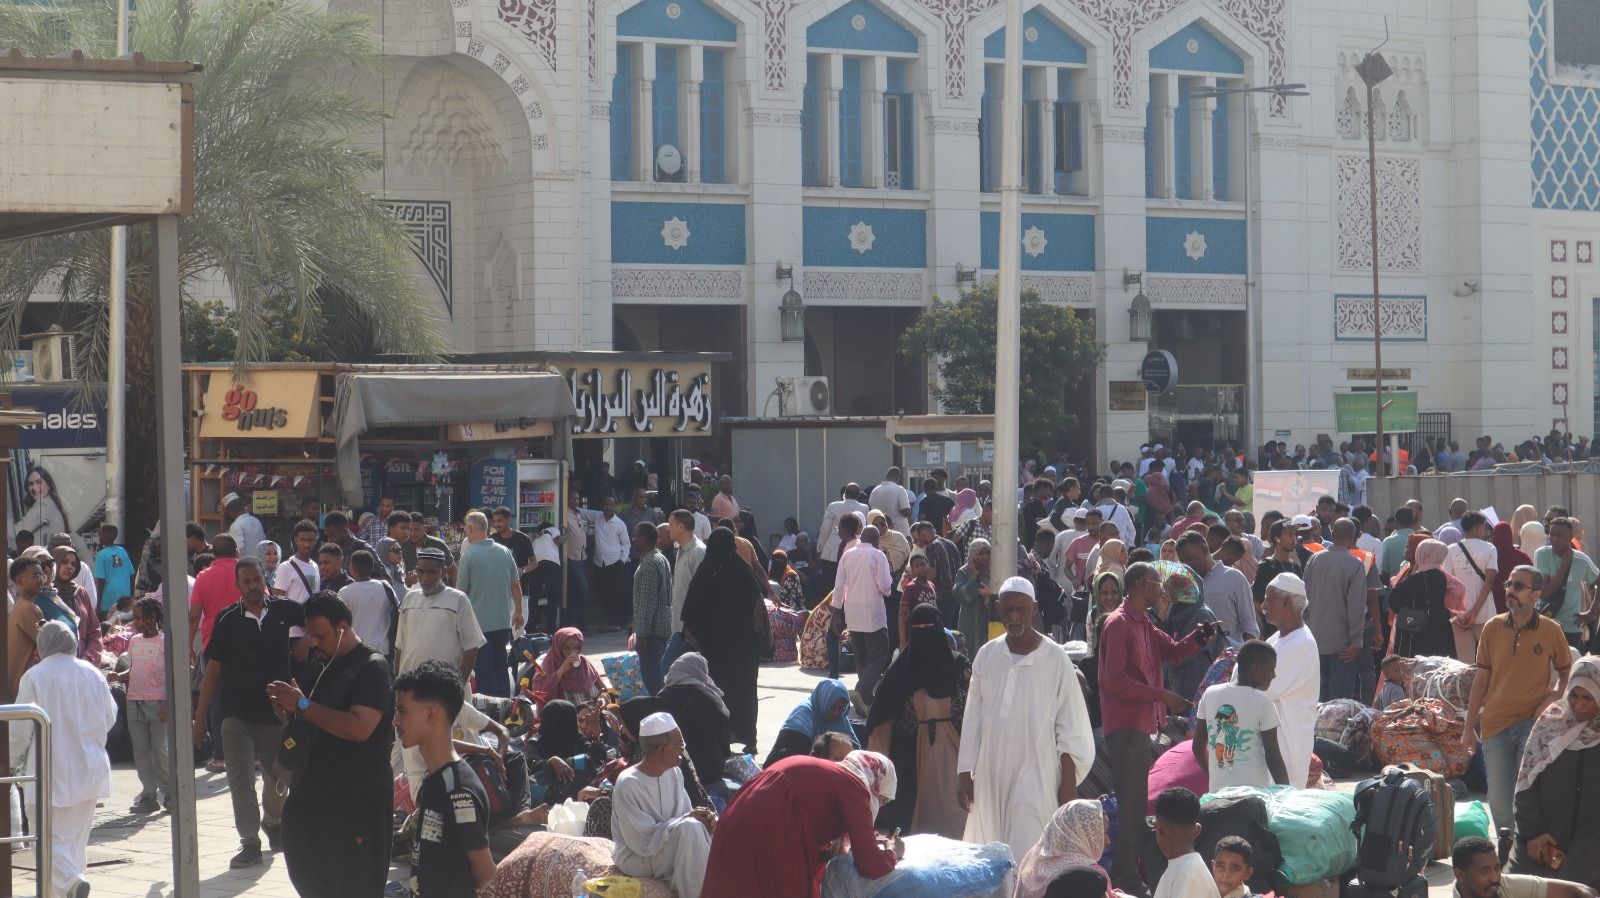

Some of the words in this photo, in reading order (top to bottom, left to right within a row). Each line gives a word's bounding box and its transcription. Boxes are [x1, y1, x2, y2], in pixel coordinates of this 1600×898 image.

[221, 384, 257, 421] go
[237, 407, 288, 431] nuts
[570, 369, 632, 433] البرازيل
[632, 369, 667, 432] البن
[669, 371, 711, 432] زهرة
[483, 466, 506, 476] FOR
